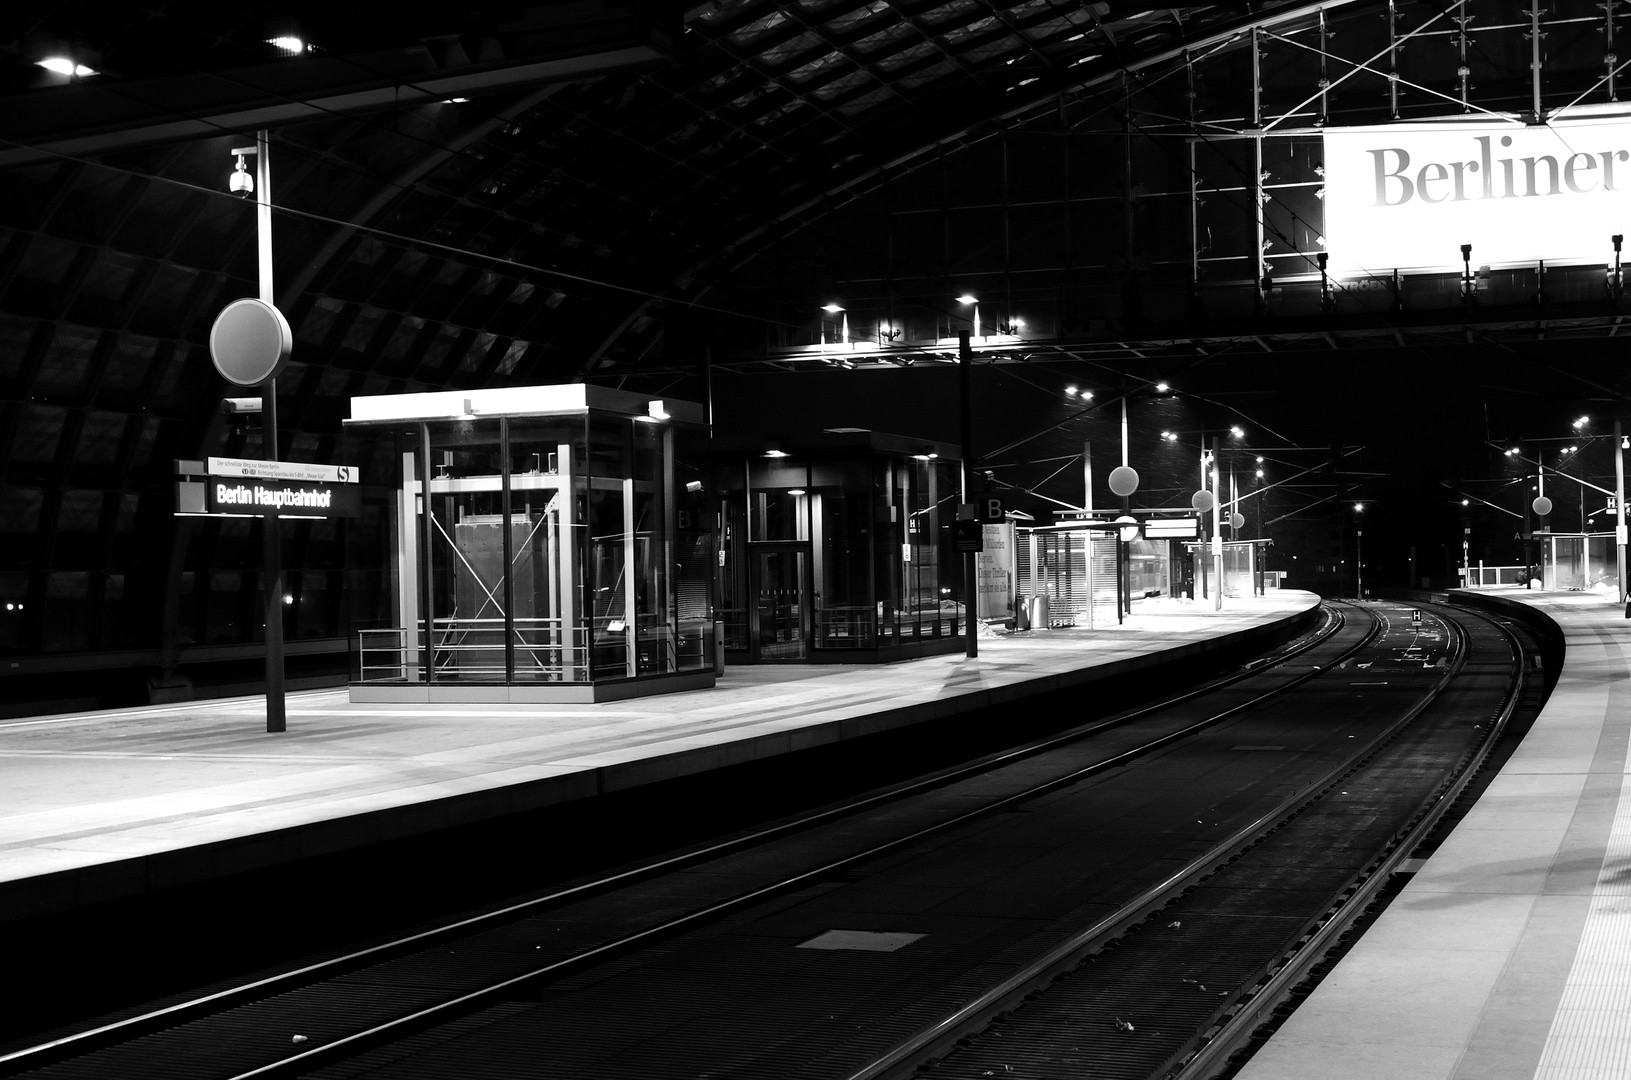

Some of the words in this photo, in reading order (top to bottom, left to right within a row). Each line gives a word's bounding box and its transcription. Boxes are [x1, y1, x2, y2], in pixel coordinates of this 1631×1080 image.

[1366, 136, 1629, 207] Berliner
[217, 484, 252, 504] Berlin
[255, 486, 331, 509] Hauptbahnhof
[988, 499, 1002, 518] B
[1413, 610, 1421, 620] H
